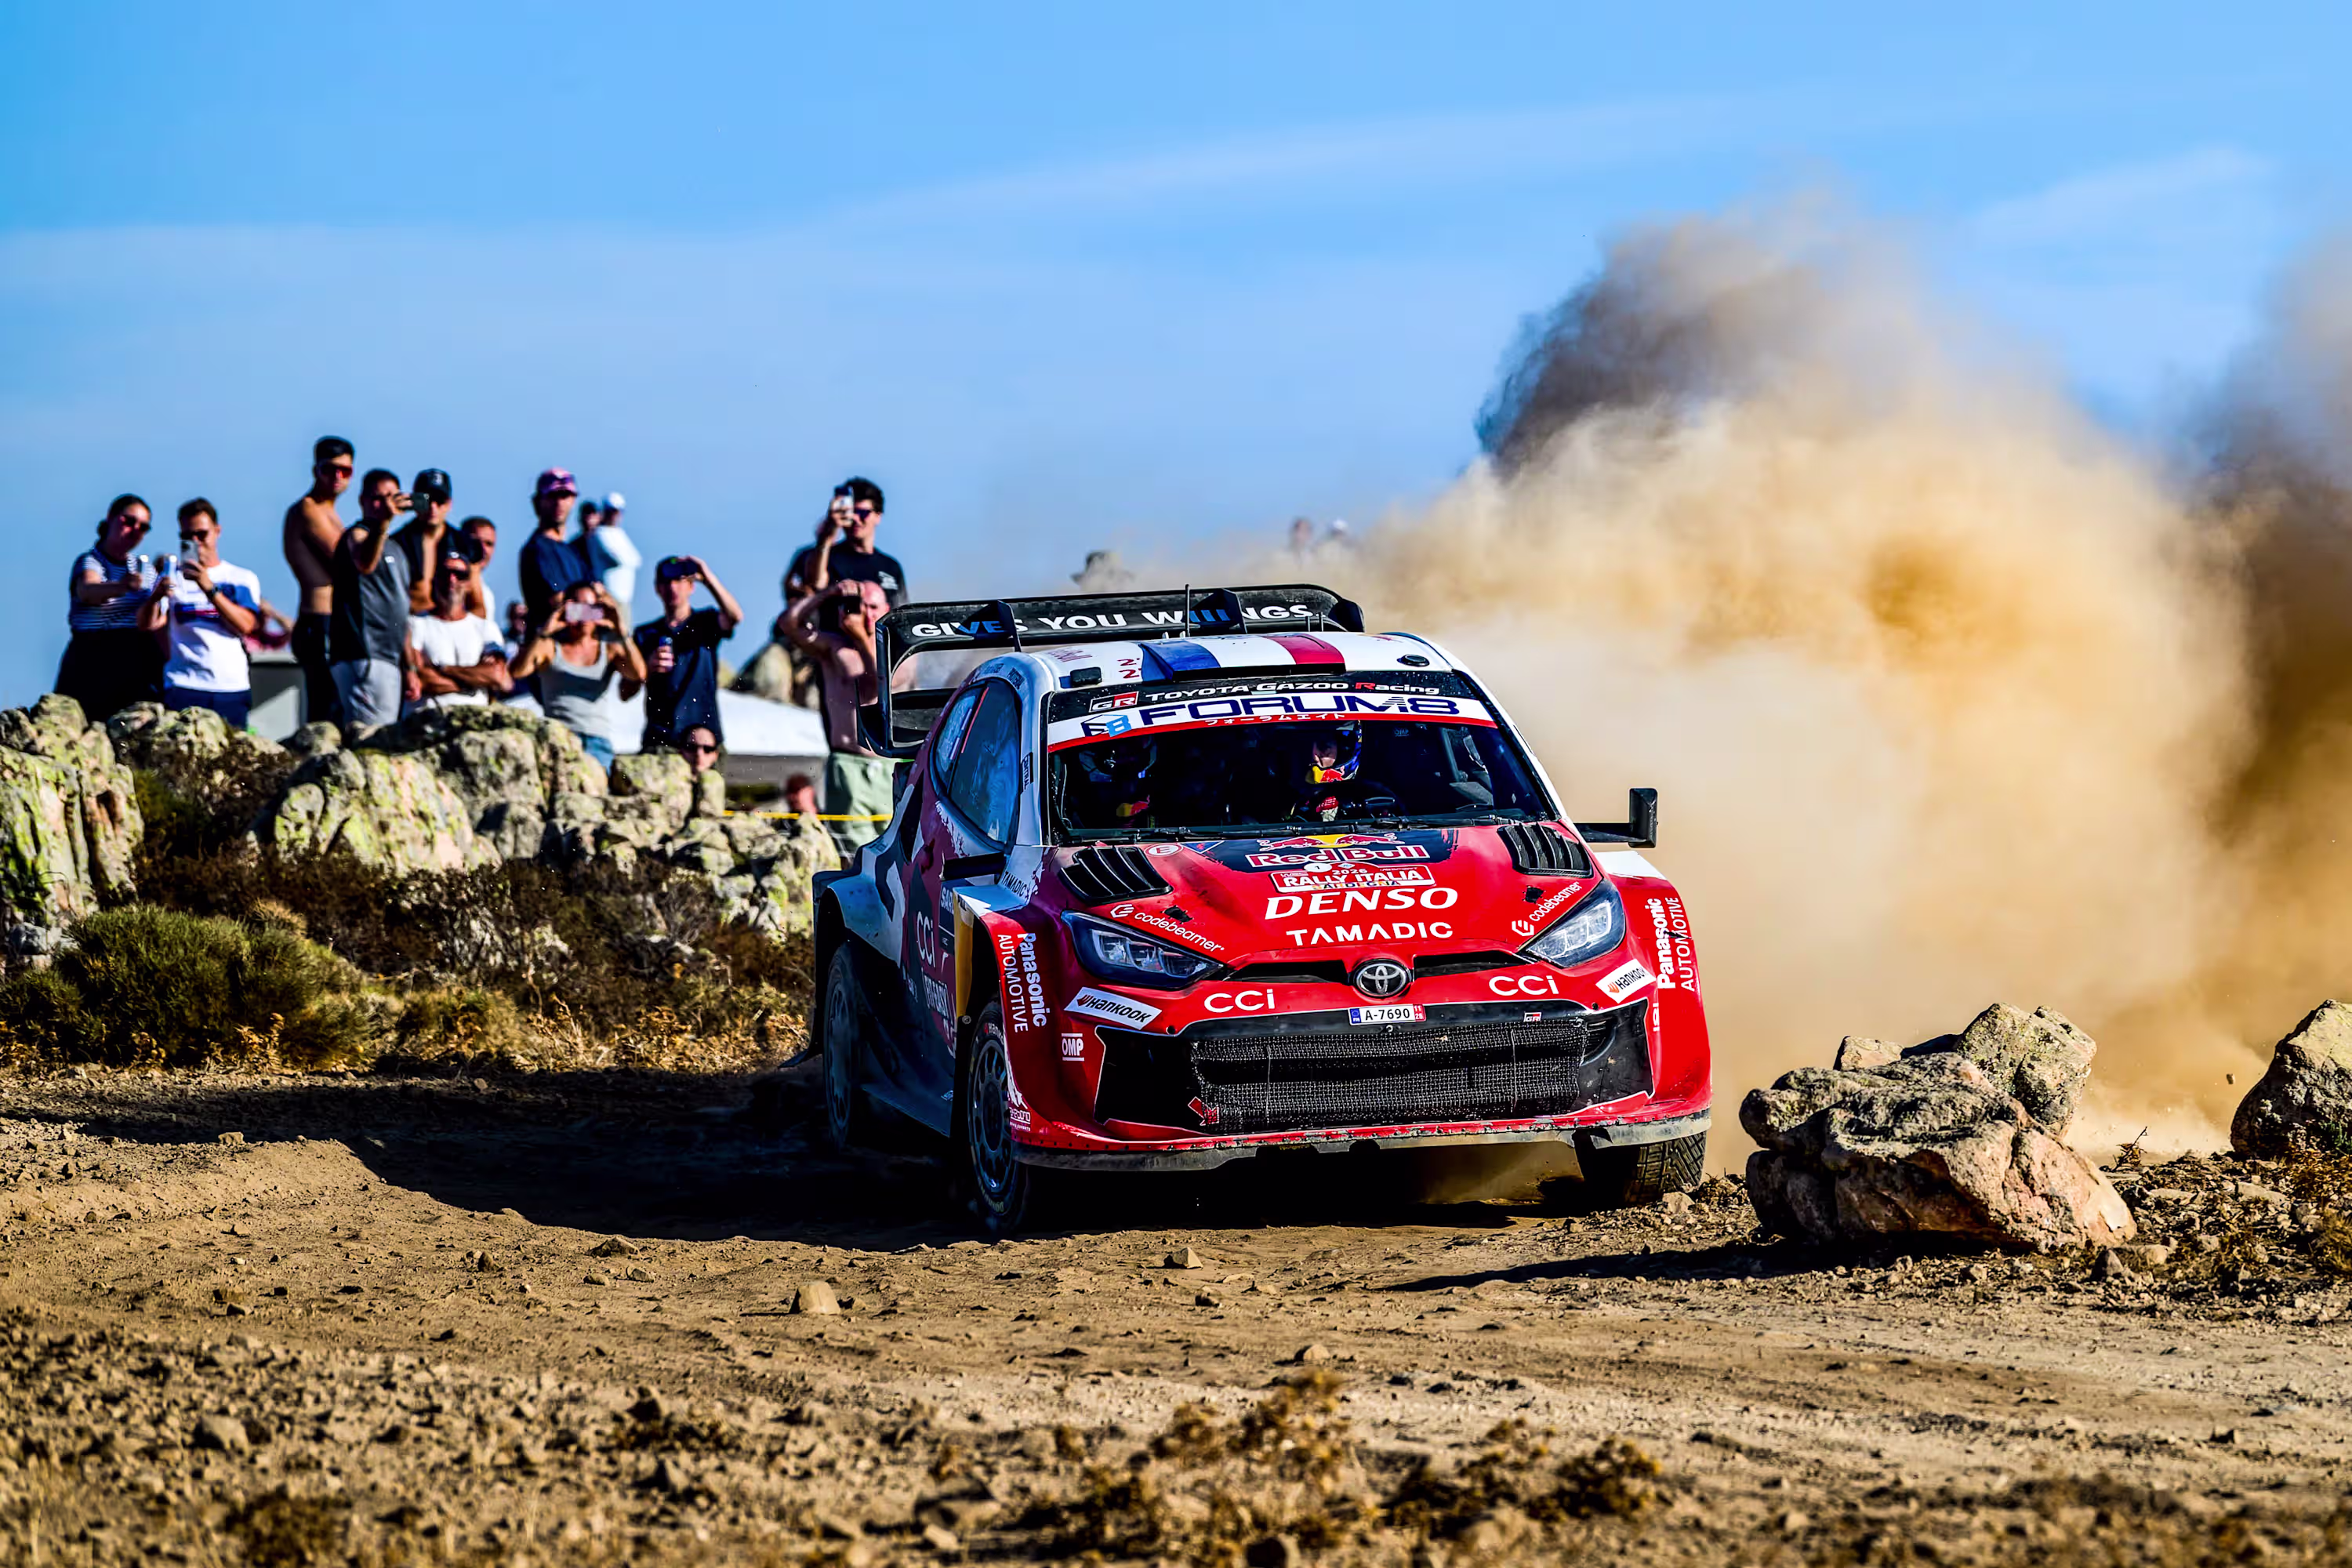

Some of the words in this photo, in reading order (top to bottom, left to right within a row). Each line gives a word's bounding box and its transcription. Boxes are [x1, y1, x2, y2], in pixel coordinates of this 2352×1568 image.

[1037, 614, 1127, 630] YOU
[1091, 695, 1137, 711] GR
[1145, 686, 1250, 702] TOYOTA
[1256, 682, 1349, 691] GAZOO
[1355, 682, 1440, 695] Racing
[1138, 695, 1460, 726] FORUM8
[1205, 713, 1345, 726] フォーラムエイト
[1245, 848, 1334, 868] Red
[1338, 844, 1431, 862] Bull
[1002, 870, 1027, 897] TAMADIC
[1283, 873, 1348, 887] RALLY
[1356, 869, 1425, 883] ITALIA
[1312, 880, 1402, 891] SARDEGNA
[1265, 887, 1458, 920] DENSO
[1529, 881, 1582, 921] codebeamer
[1134, 912, 1222, 952] codebeamer
[1286, 922, 1454, 946] TAMADIC
[1645, 898, 1676, 989] Panasonic
[1664, 897, 1695, 992] AUTOMOTIVE
[997, 934, 1029, 1033] AUTOMOTIVE
[1017, 933, 1051, 1027] Panasonic
[1365, 1008, 1410, 1021] A-7690
[1062, 1037, 1084, 1057] OMP
